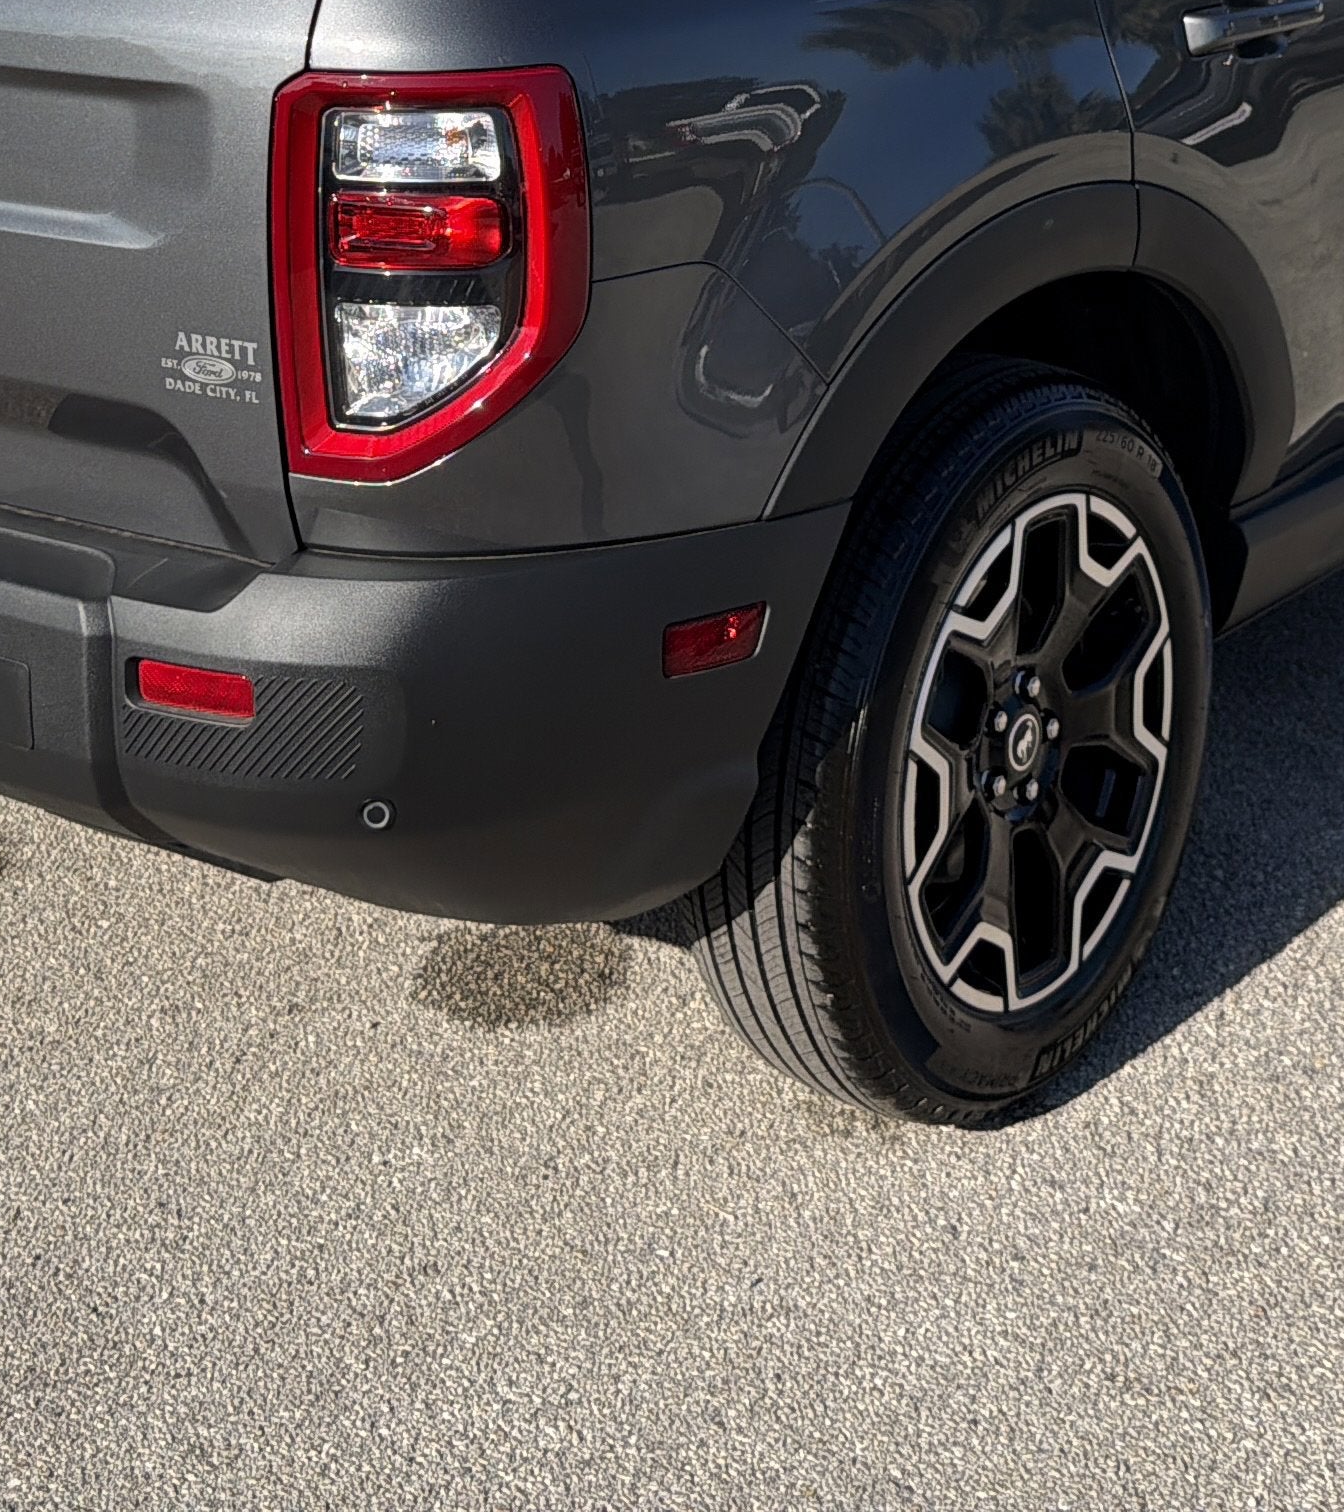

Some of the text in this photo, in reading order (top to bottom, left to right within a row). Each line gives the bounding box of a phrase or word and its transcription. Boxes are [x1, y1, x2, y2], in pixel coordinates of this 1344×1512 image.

[175, 331, 258, 365] ARRETT
[161, 357, 181, 370] EST.
[193, 360, 224, 379] Ford
[165, 377, 260, 404] DADE CITY, FL
[976, 430, 1080, 520] MICHELIN
